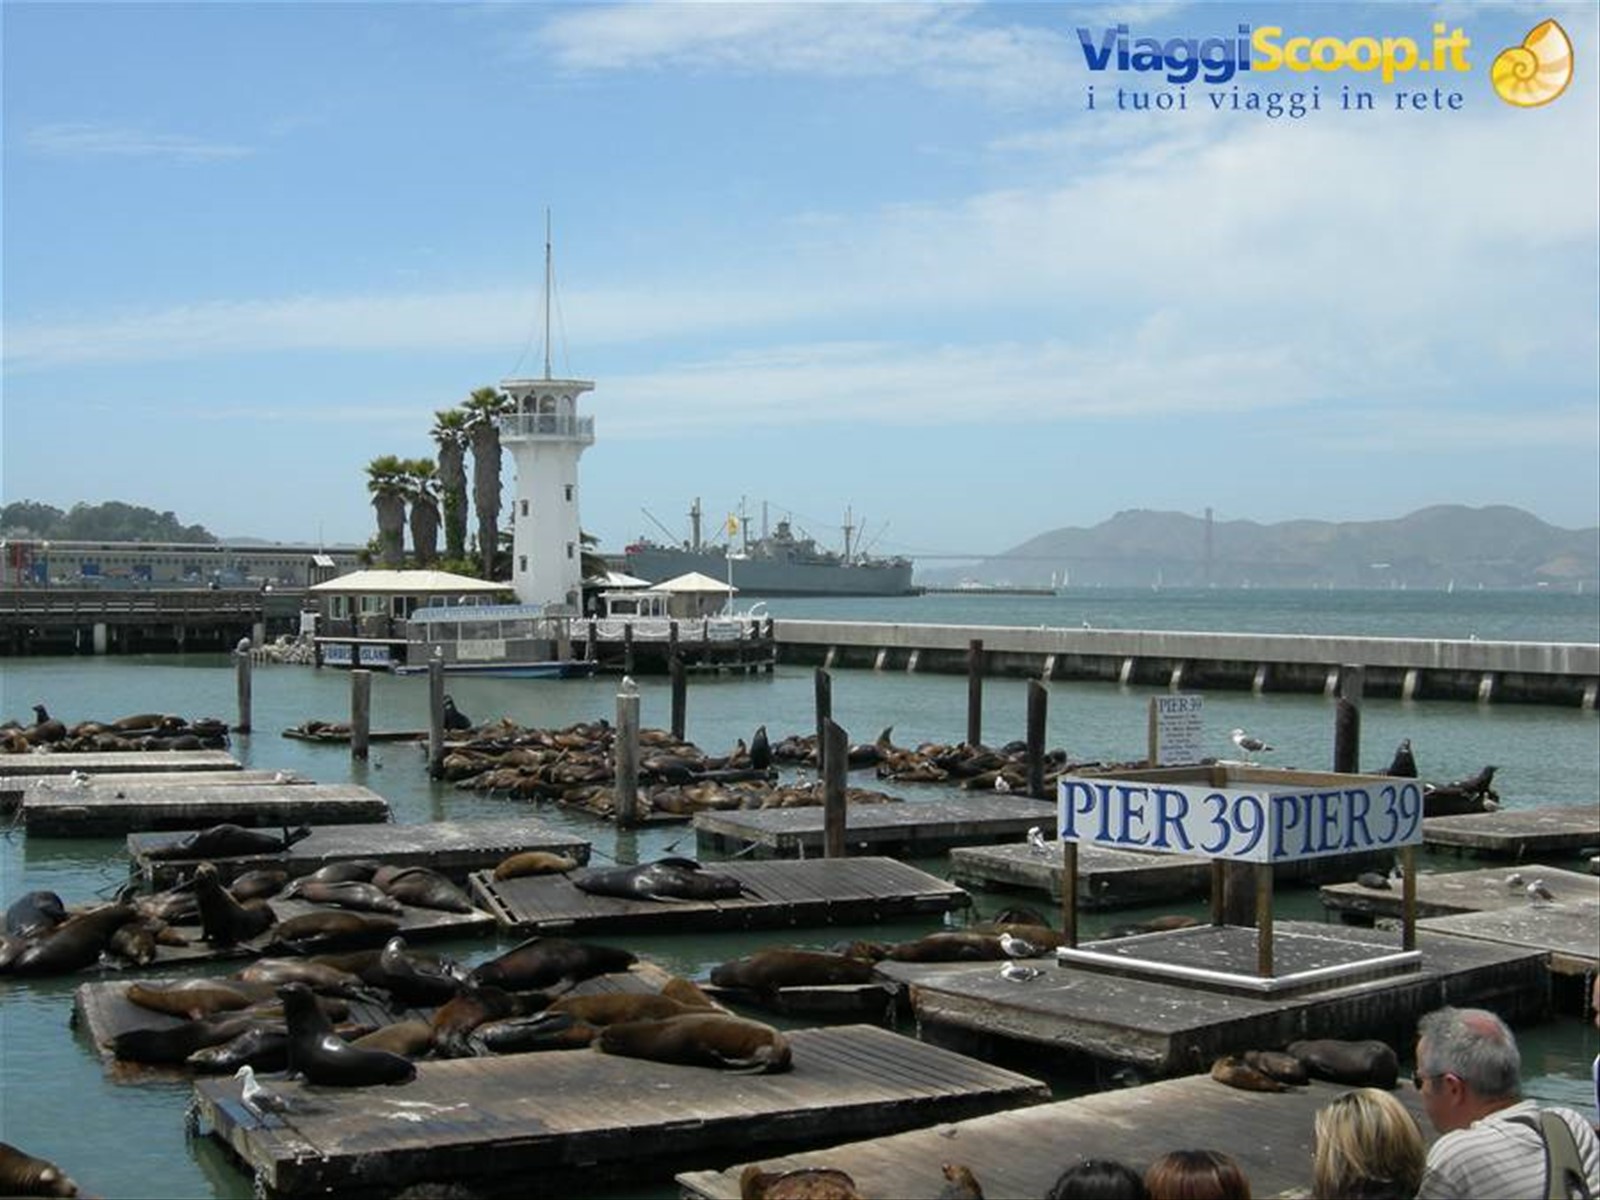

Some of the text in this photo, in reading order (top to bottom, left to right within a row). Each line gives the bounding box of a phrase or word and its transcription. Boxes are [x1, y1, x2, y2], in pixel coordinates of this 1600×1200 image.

[1159, 697, 1188, 713] PIER
[1061, 781, 1266, 856] PIER 39
[1272, 782, 1422, 857] PIER 39
